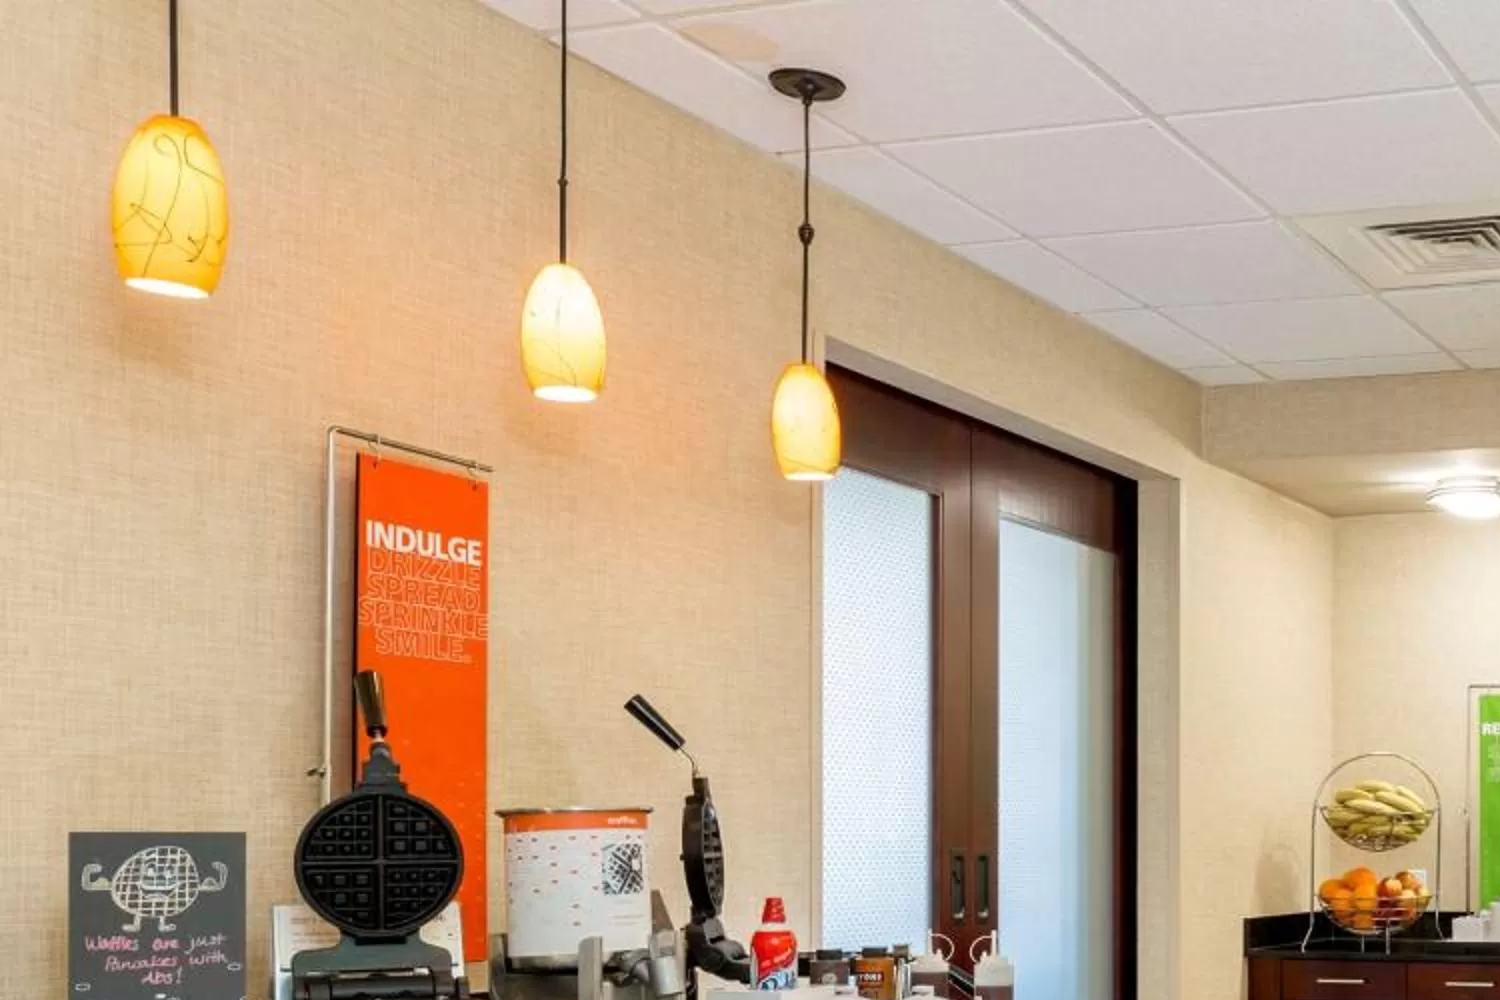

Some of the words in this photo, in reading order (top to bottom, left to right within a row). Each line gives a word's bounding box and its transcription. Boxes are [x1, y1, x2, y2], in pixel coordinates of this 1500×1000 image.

[365, 519, 482, 567] INDULGE
[369, 548, 482, 591] DRIZZLE
[368, 574, 481, 613] SPREAD
[359, 598, 488, 640] SPRINKLE
[184, 932, 227, 954] just
[189, 949, 228, 965] with
